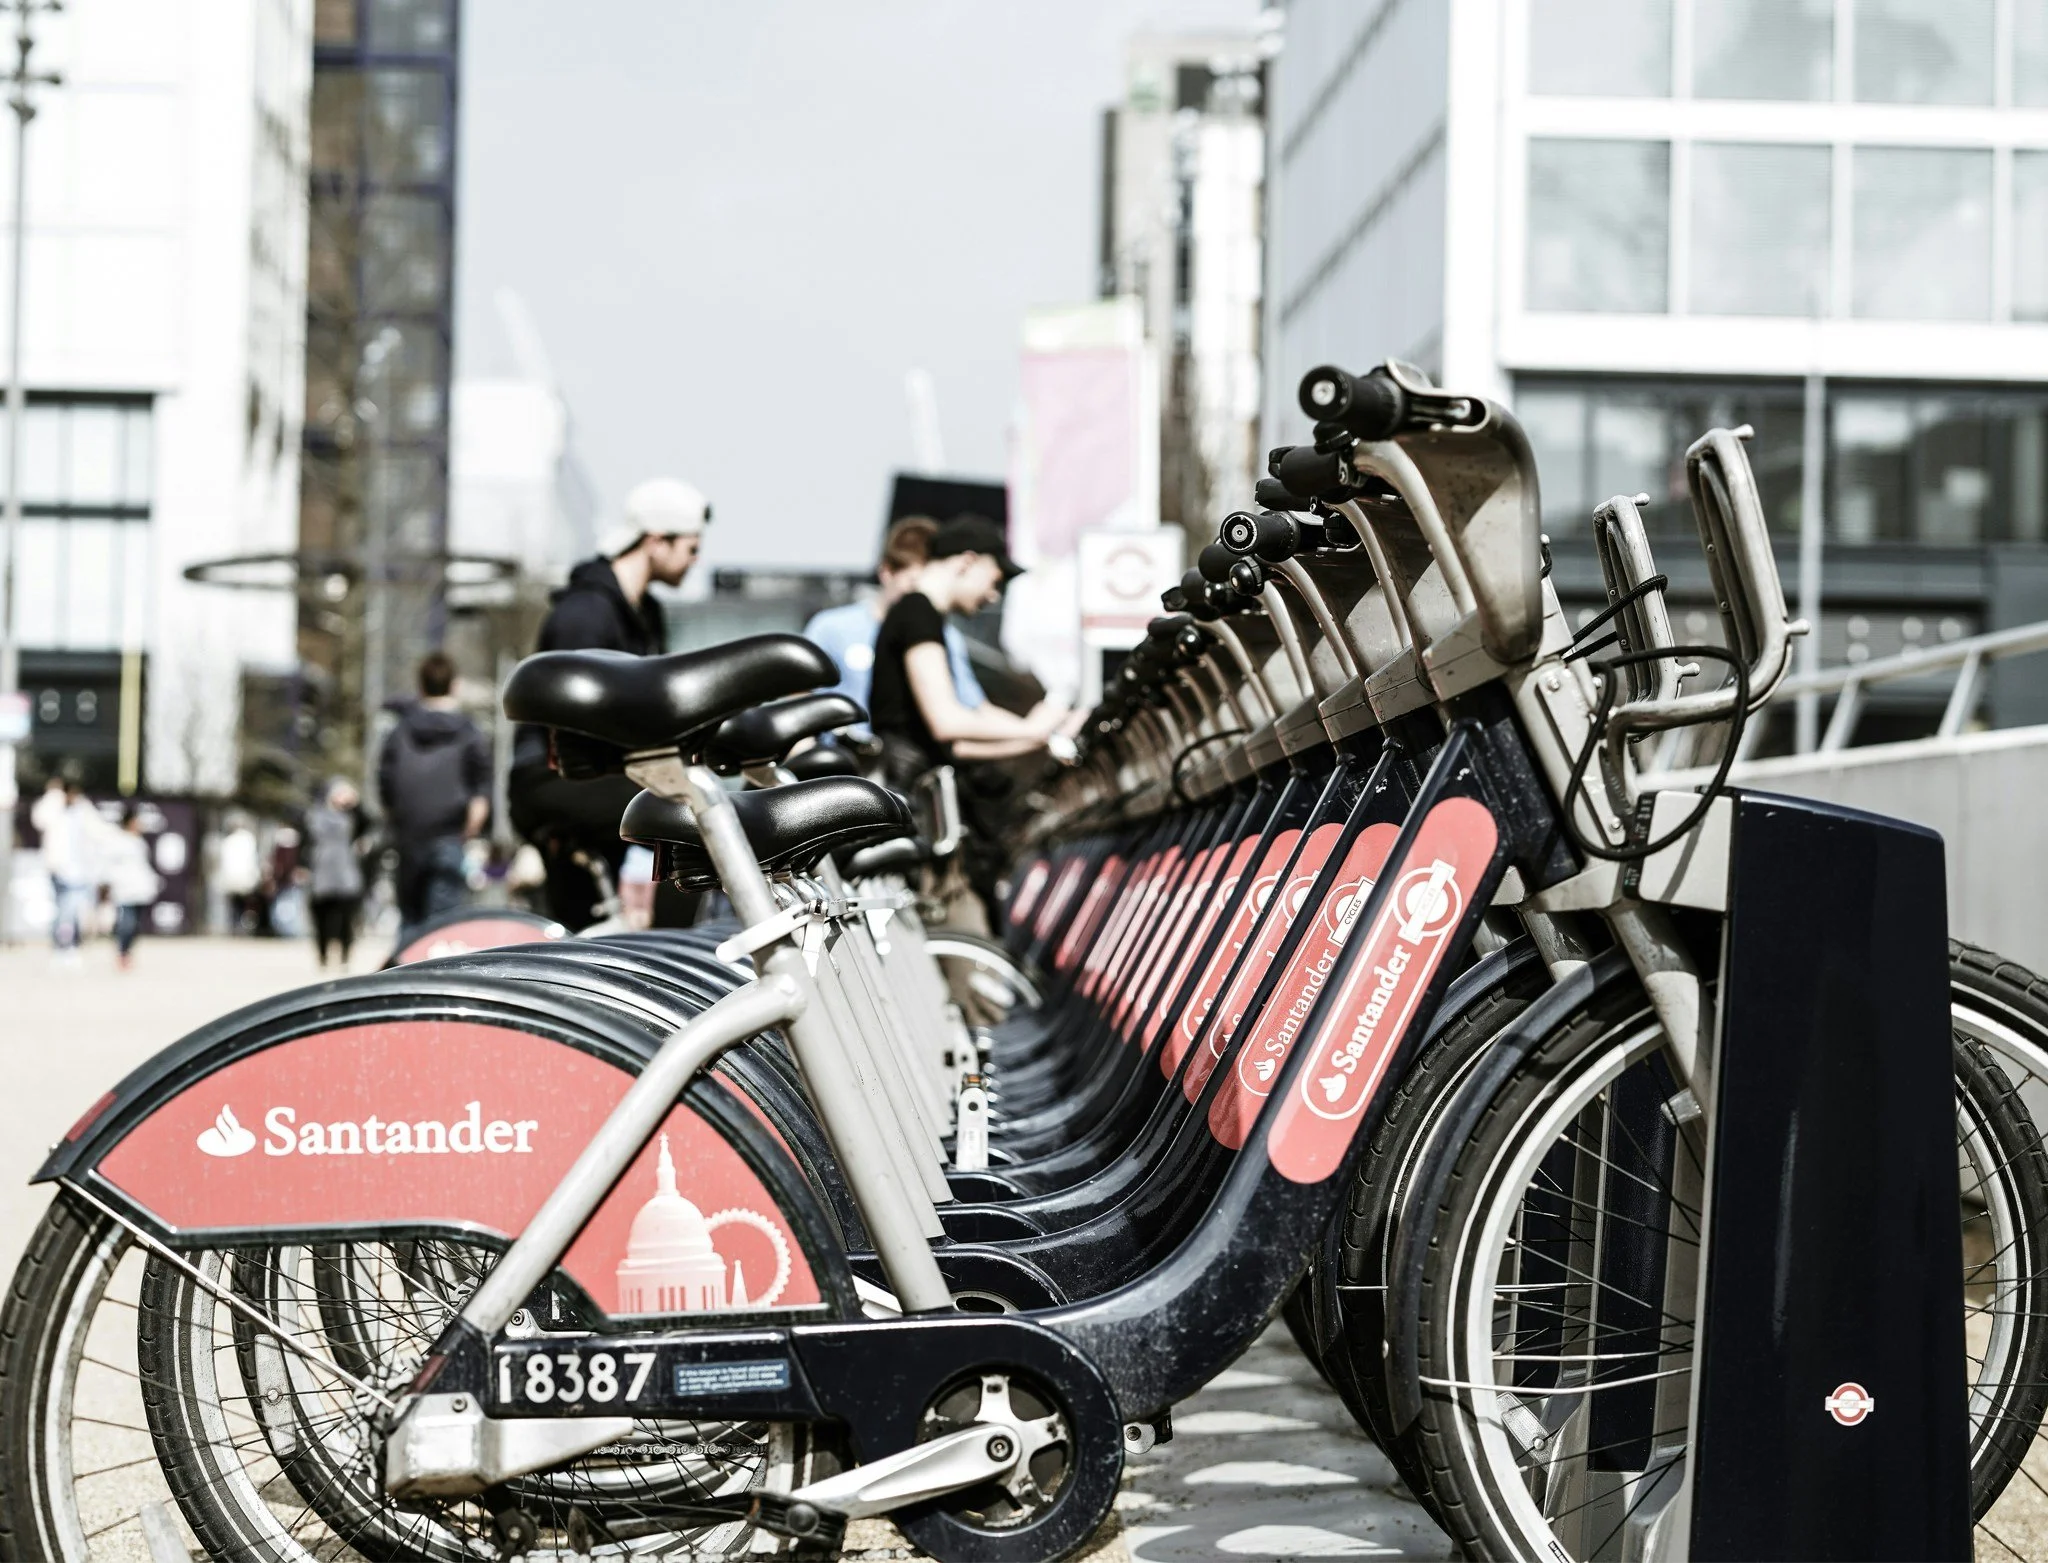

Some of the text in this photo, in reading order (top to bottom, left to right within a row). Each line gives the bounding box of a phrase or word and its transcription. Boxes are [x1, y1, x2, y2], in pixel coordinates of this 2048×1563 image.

[1344, 899, 1362, 925] CYCLES
[1264, 948, 1336, 1057] Santander
[1331, 944, 1412, 1074] Santander
[264, 1101, 538, 1157] Santander
[498, 1353, 656, 1403] 18387
